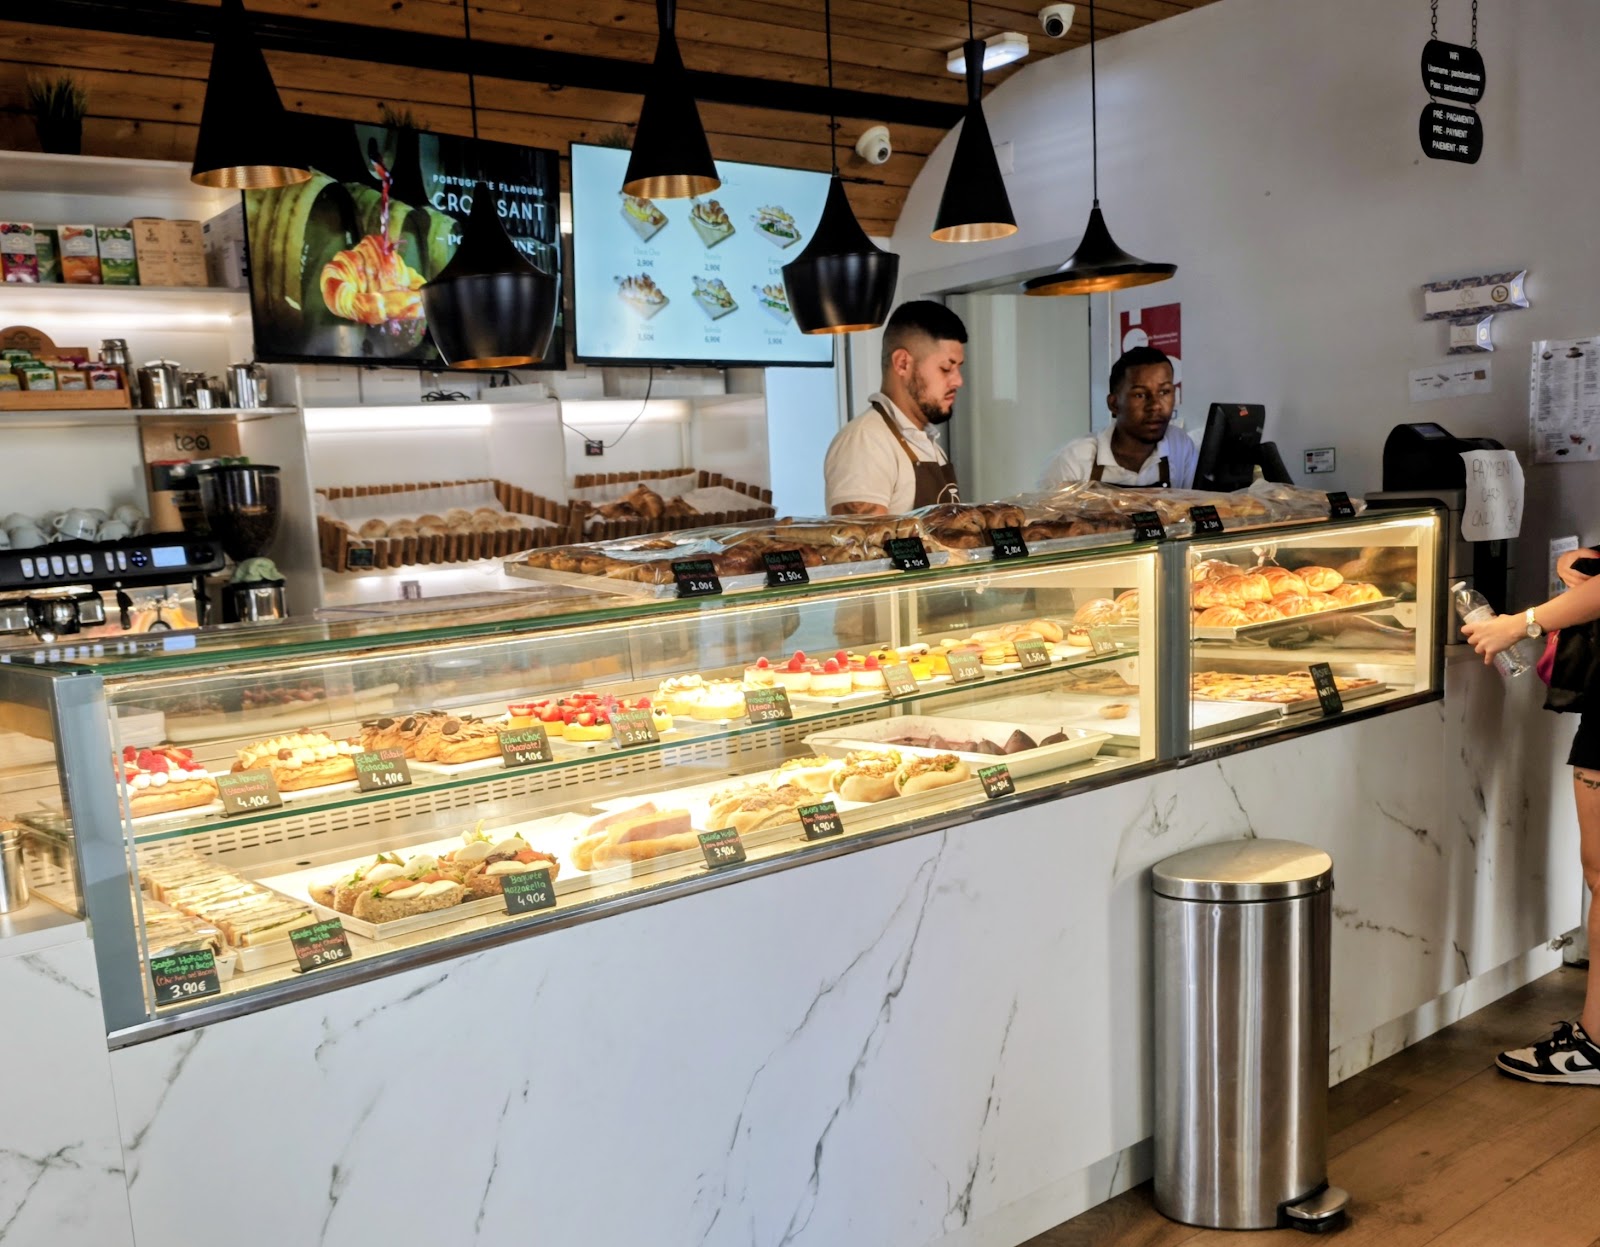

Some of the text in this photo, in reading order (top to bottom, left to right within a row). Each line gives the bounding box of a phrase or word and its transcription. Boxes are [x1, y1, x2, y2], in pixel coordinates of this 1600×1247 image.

[1446, 112, 1475, 125] PAGAMENTO
[1432, 125, 1443, 135] PRE
[1446, 127, 1468, 139] PAYMENT
[1458, 144, 1469, 155] PRE
[499, 182, 544, 197] FLAVOURS
[432, 192, 545, 221] CROSANT
[174, 432, 211, 452] tea
[1472, 458, 1515, 481] PAYMENT
[1471, 511, 1498, 527] ONLY
[690, 581, 714, 592] 2.00€
[761, 709, 785, 720] 3.50€
[522, 731, 542, 742] Choc
[625, 730, 653, 742] 3.50€
[714, 846, 736, 858] 3.90€
[312, 948, 344, 964] 3.90€
[169, 980, 206, 999] 3.90€
